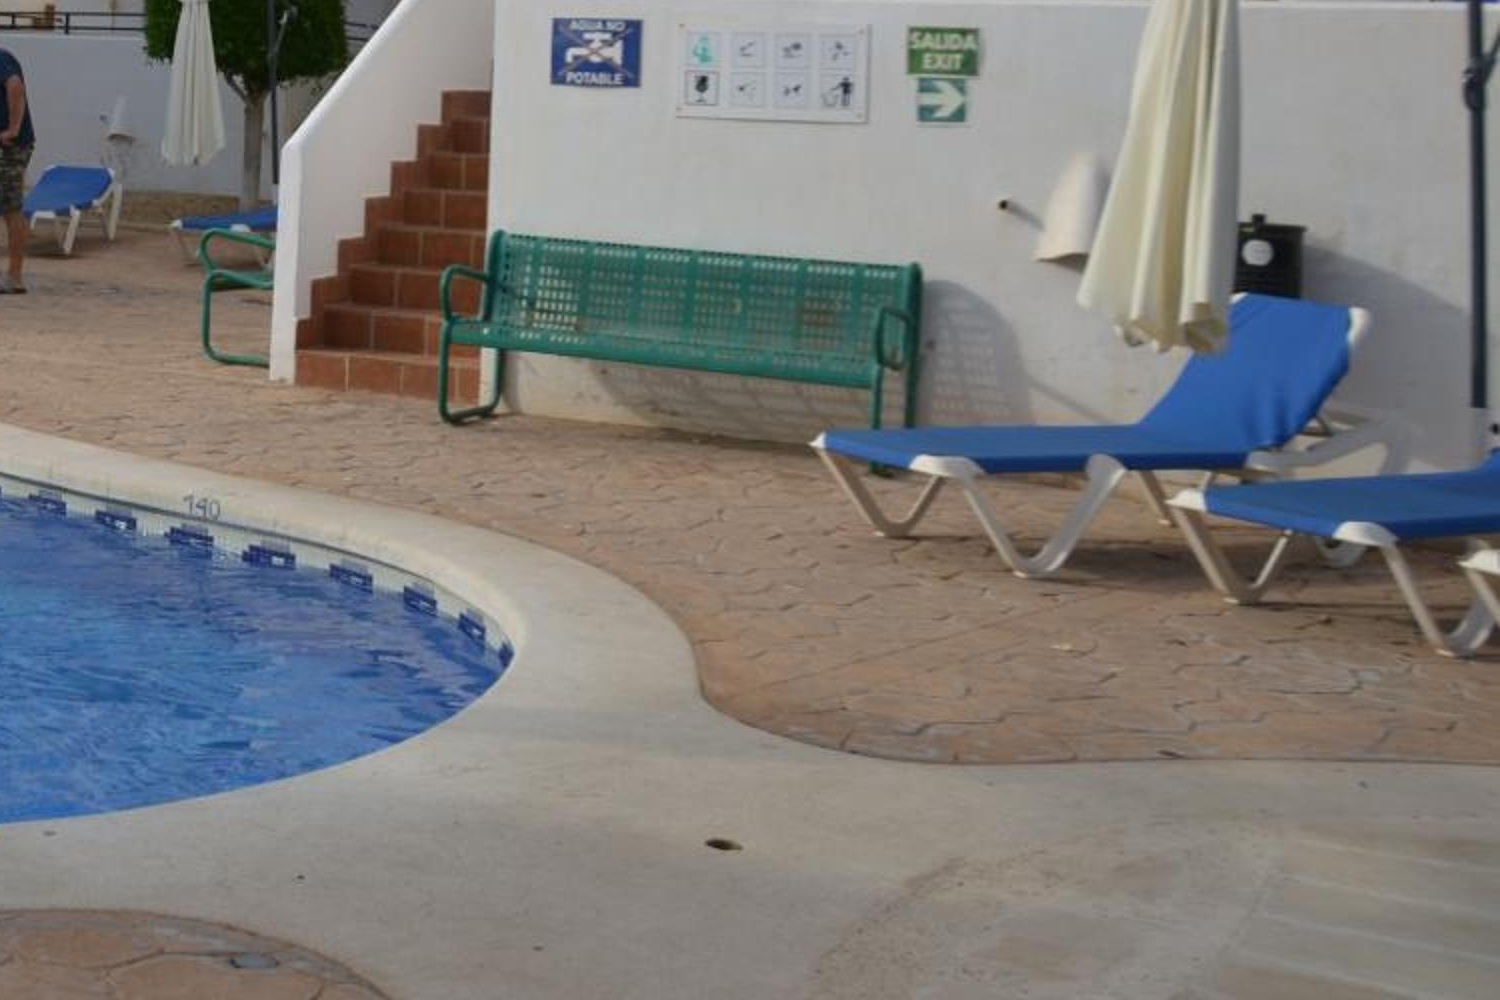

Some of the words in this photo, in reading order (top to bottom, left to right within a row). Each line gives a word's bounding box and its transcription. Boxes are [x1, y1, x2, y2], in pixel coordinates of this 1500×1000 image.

[910, 31, 977, 51] SALIDA
[921, 51, 963, 71] EXIT
[566, 71, 624, 85] POTABLE
